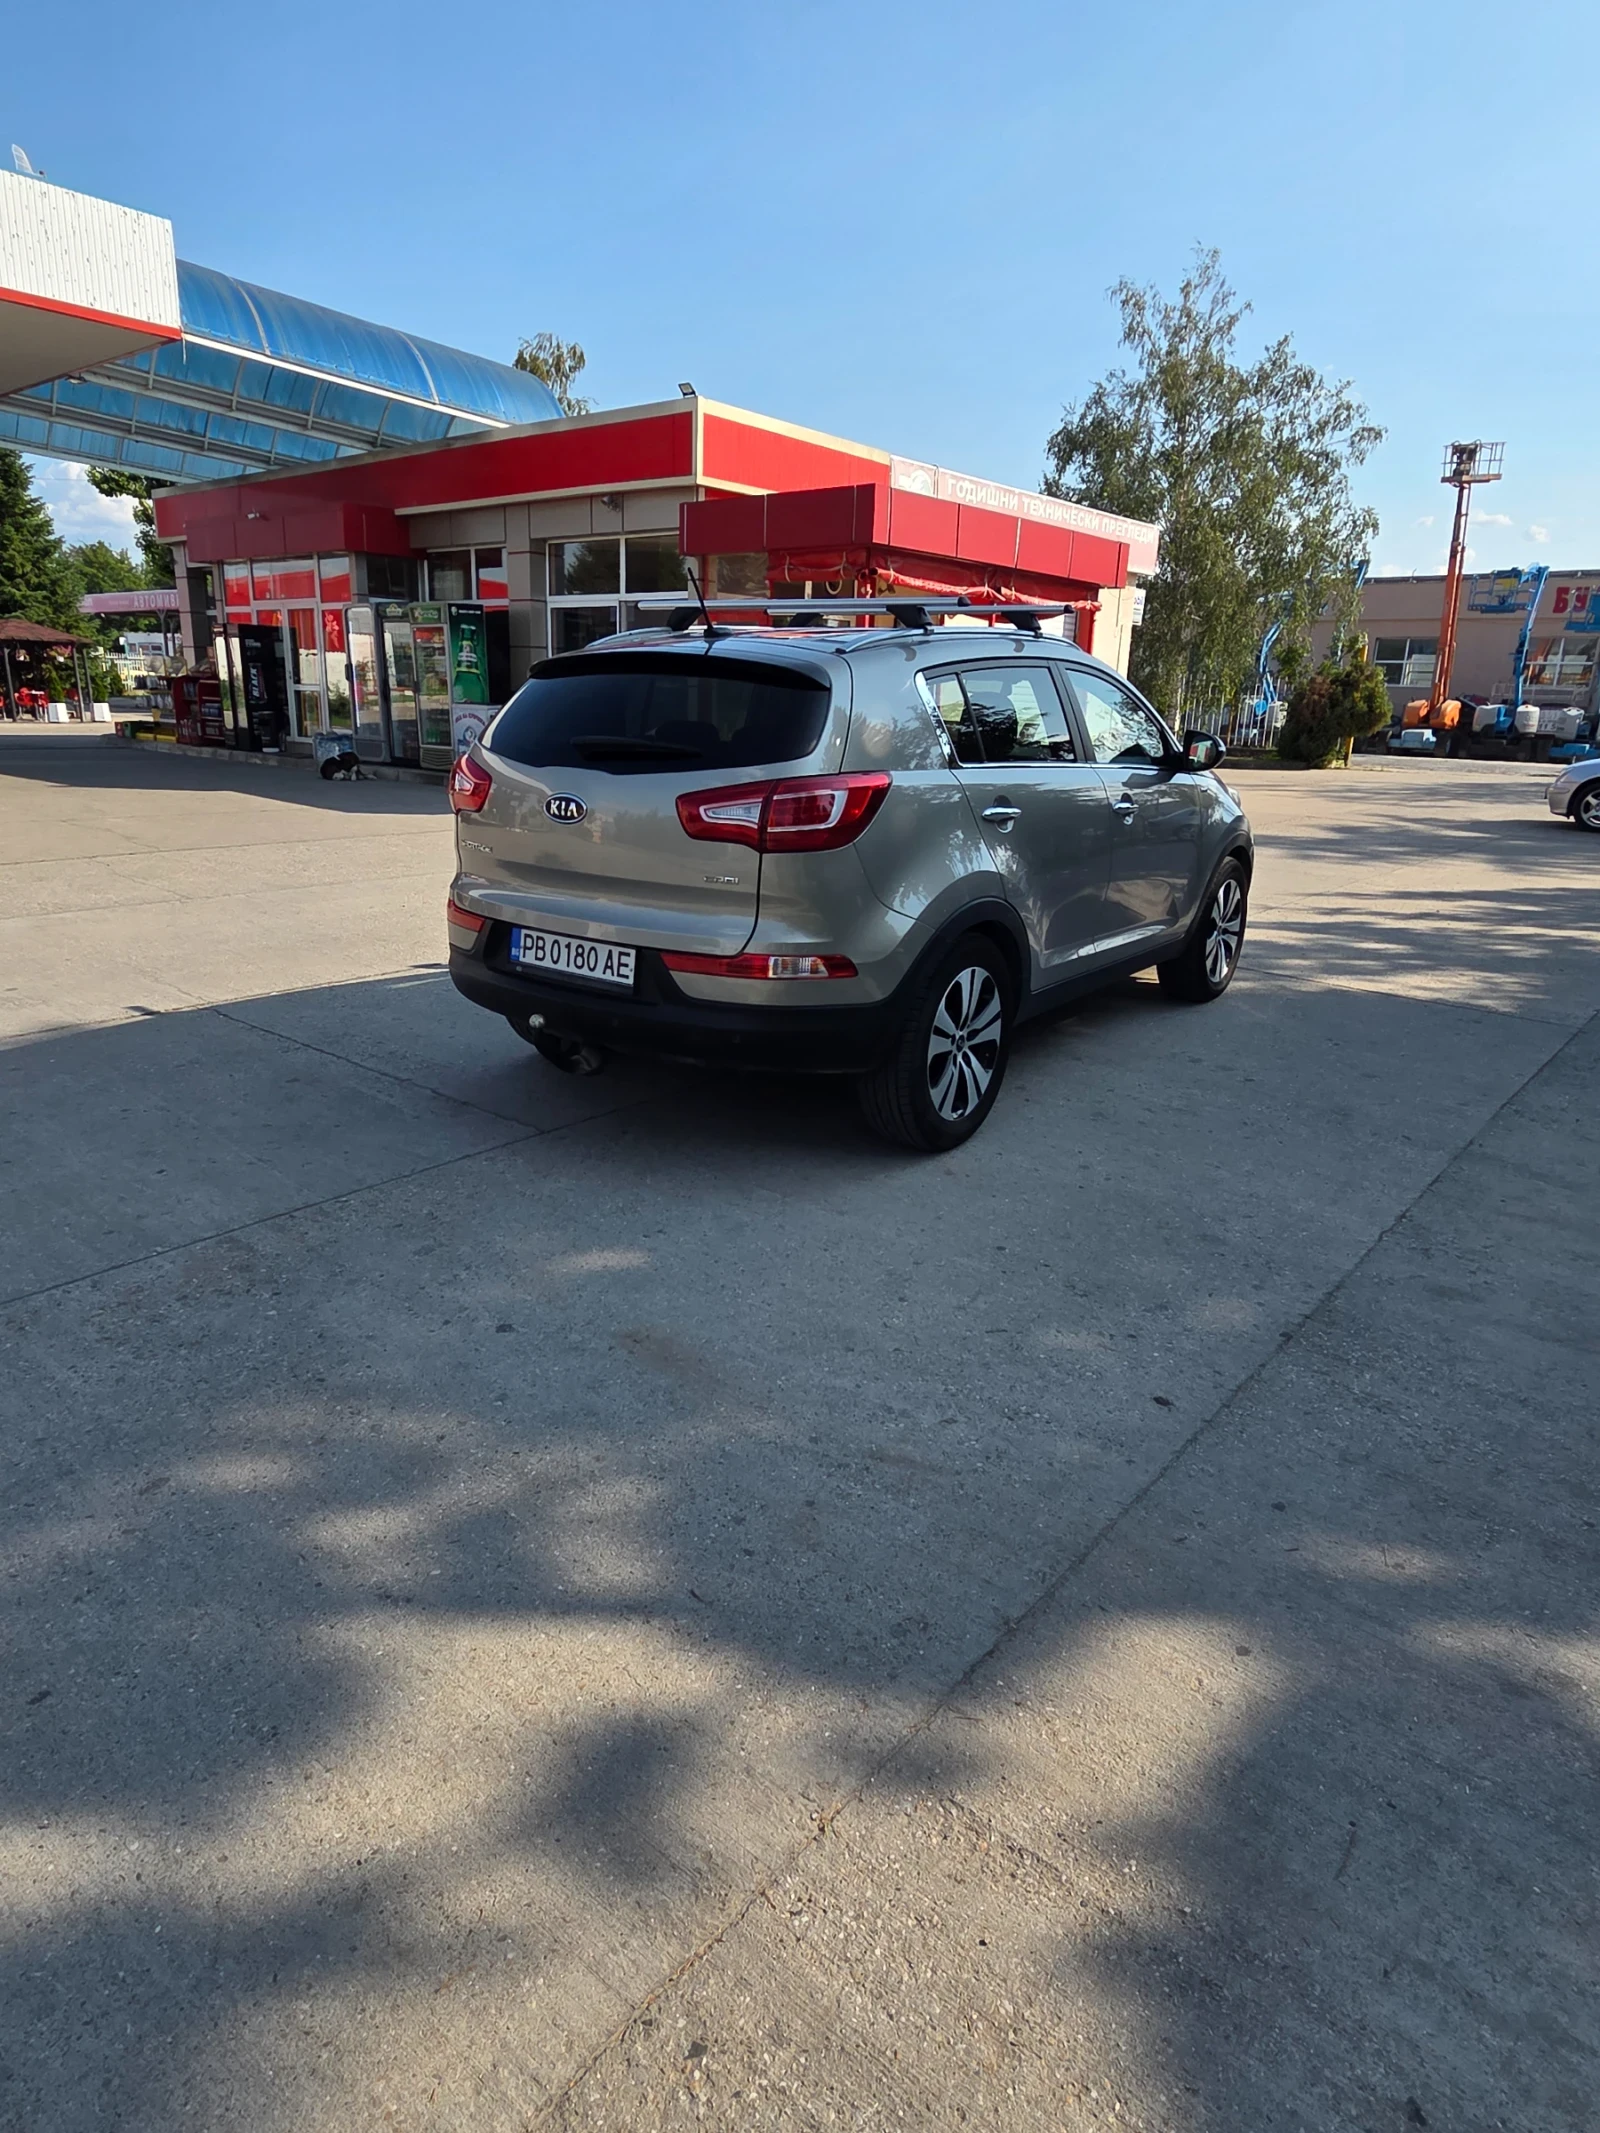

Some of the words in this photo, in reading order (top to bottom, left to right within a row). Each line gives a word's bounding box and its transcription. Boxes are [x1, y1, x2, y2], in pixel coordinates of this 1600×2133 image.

[947, 478, 1019, 511] ГОДИШНИ
[1021, 497, 1099, 531] ТЕХНИЧЕСКИ
[1101, 520, 1155, 543] ПРЕГЛЕДИ
[248, 667, 261, 698] BLACK
[549, 799, 579, 818] KIA
